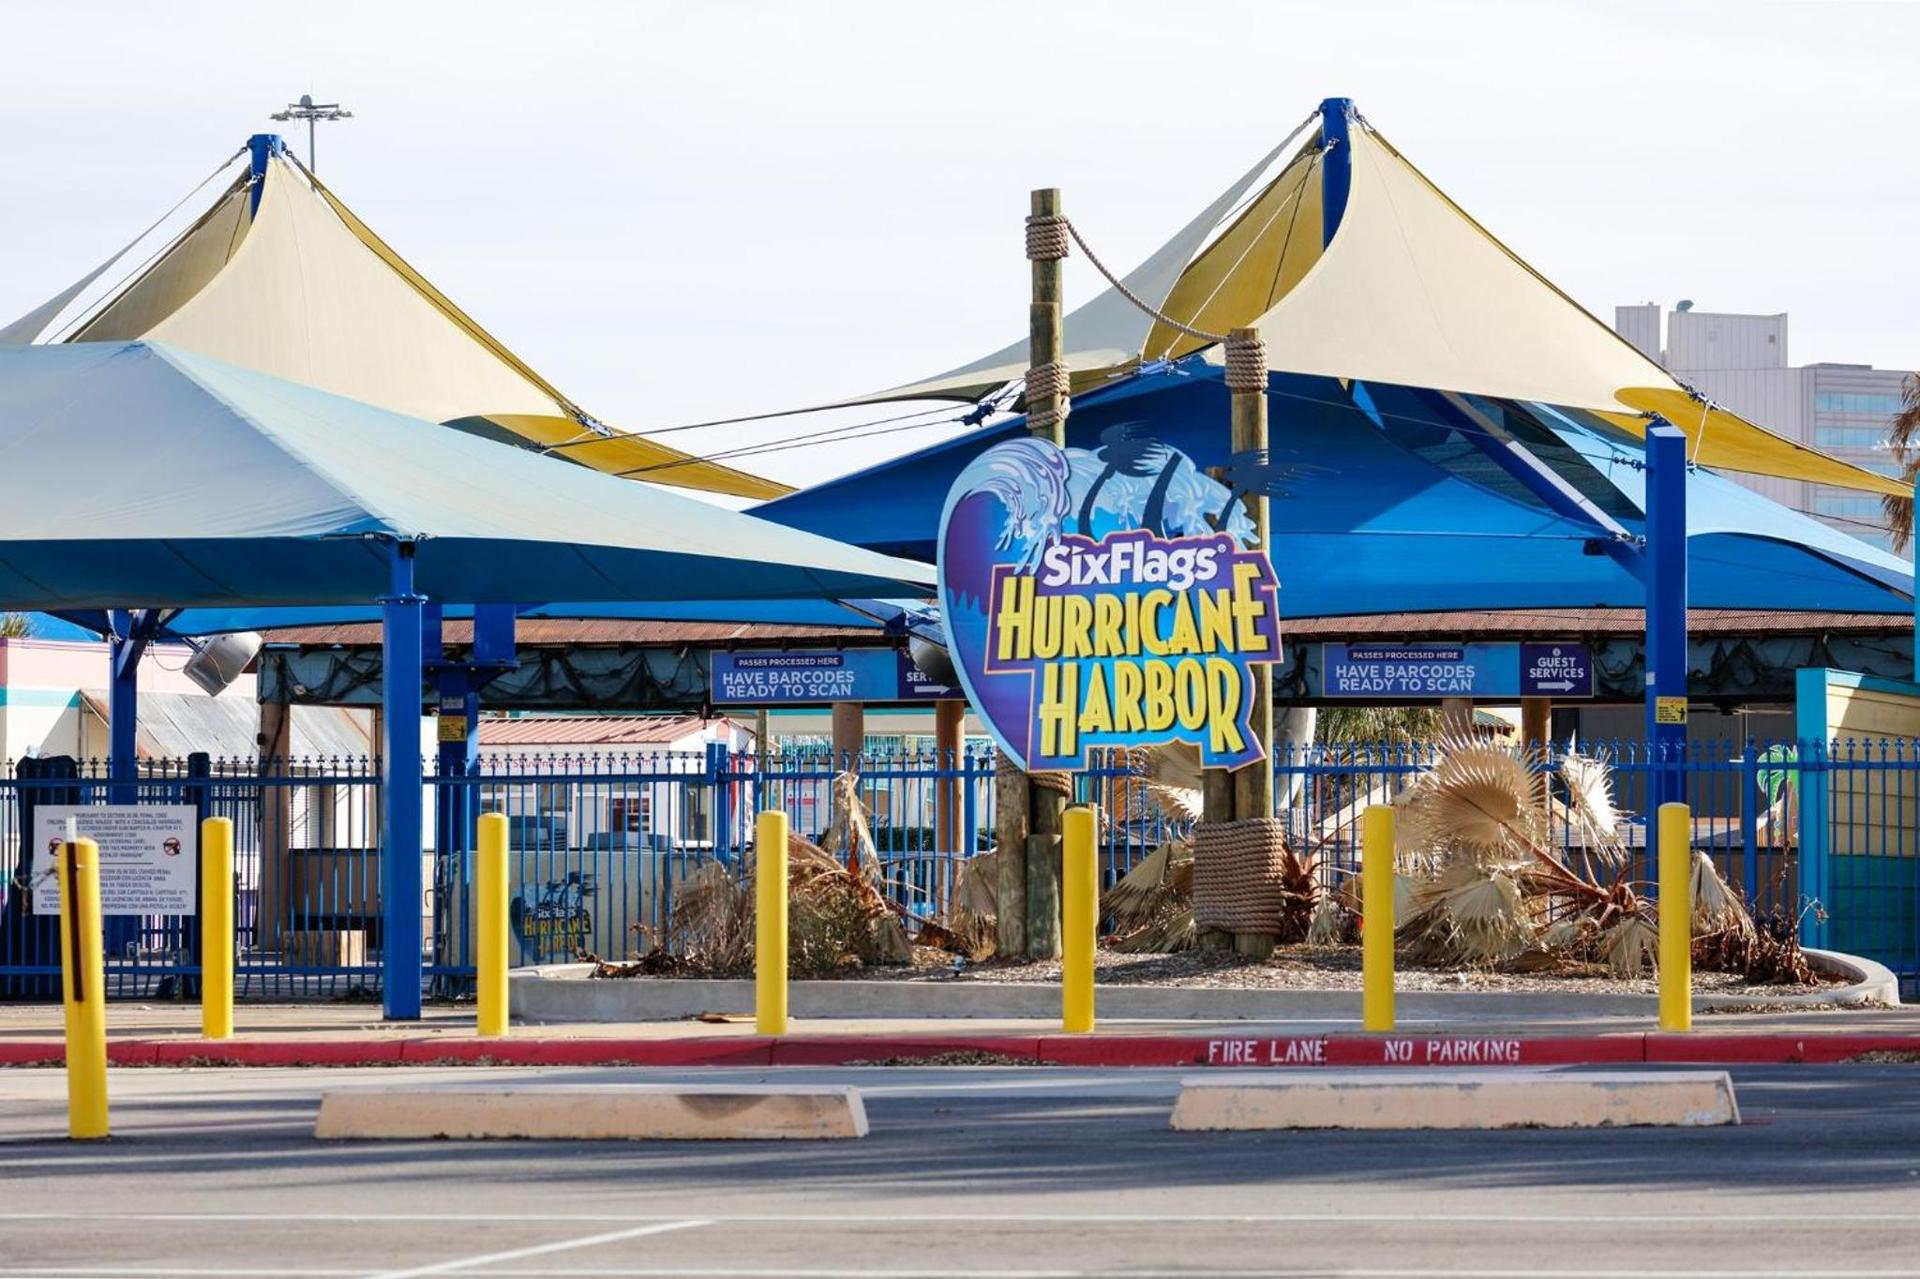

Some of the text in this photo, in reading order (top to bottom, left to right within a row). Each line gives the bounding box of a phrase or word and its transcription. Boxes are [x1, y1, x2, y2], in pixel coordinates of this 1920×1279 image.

[997, 563, 1268, 660] HURRICANE
[739, 657, 839, 667] PASSES PROCESSED HERE
[1353, 651, 1459, 660] PASSES PROCESSED HERE
[1538, 657, 1576, 667] GUEST
[723, 671, 855, 685] HAVE BARCODES
[1336, 664, 1476, 679] HAVE BARCODES
[1529, 667, 1585, 679] SERVICES
[726, 683, 852, 698] READY TO SCAN
[1339, 677, 1473, 692] READY TO SCAN
[1039, 658, 1245, 757] HARBOR
[1208, 1039, 1521, 1063] FIRE LANE NO PARKING
